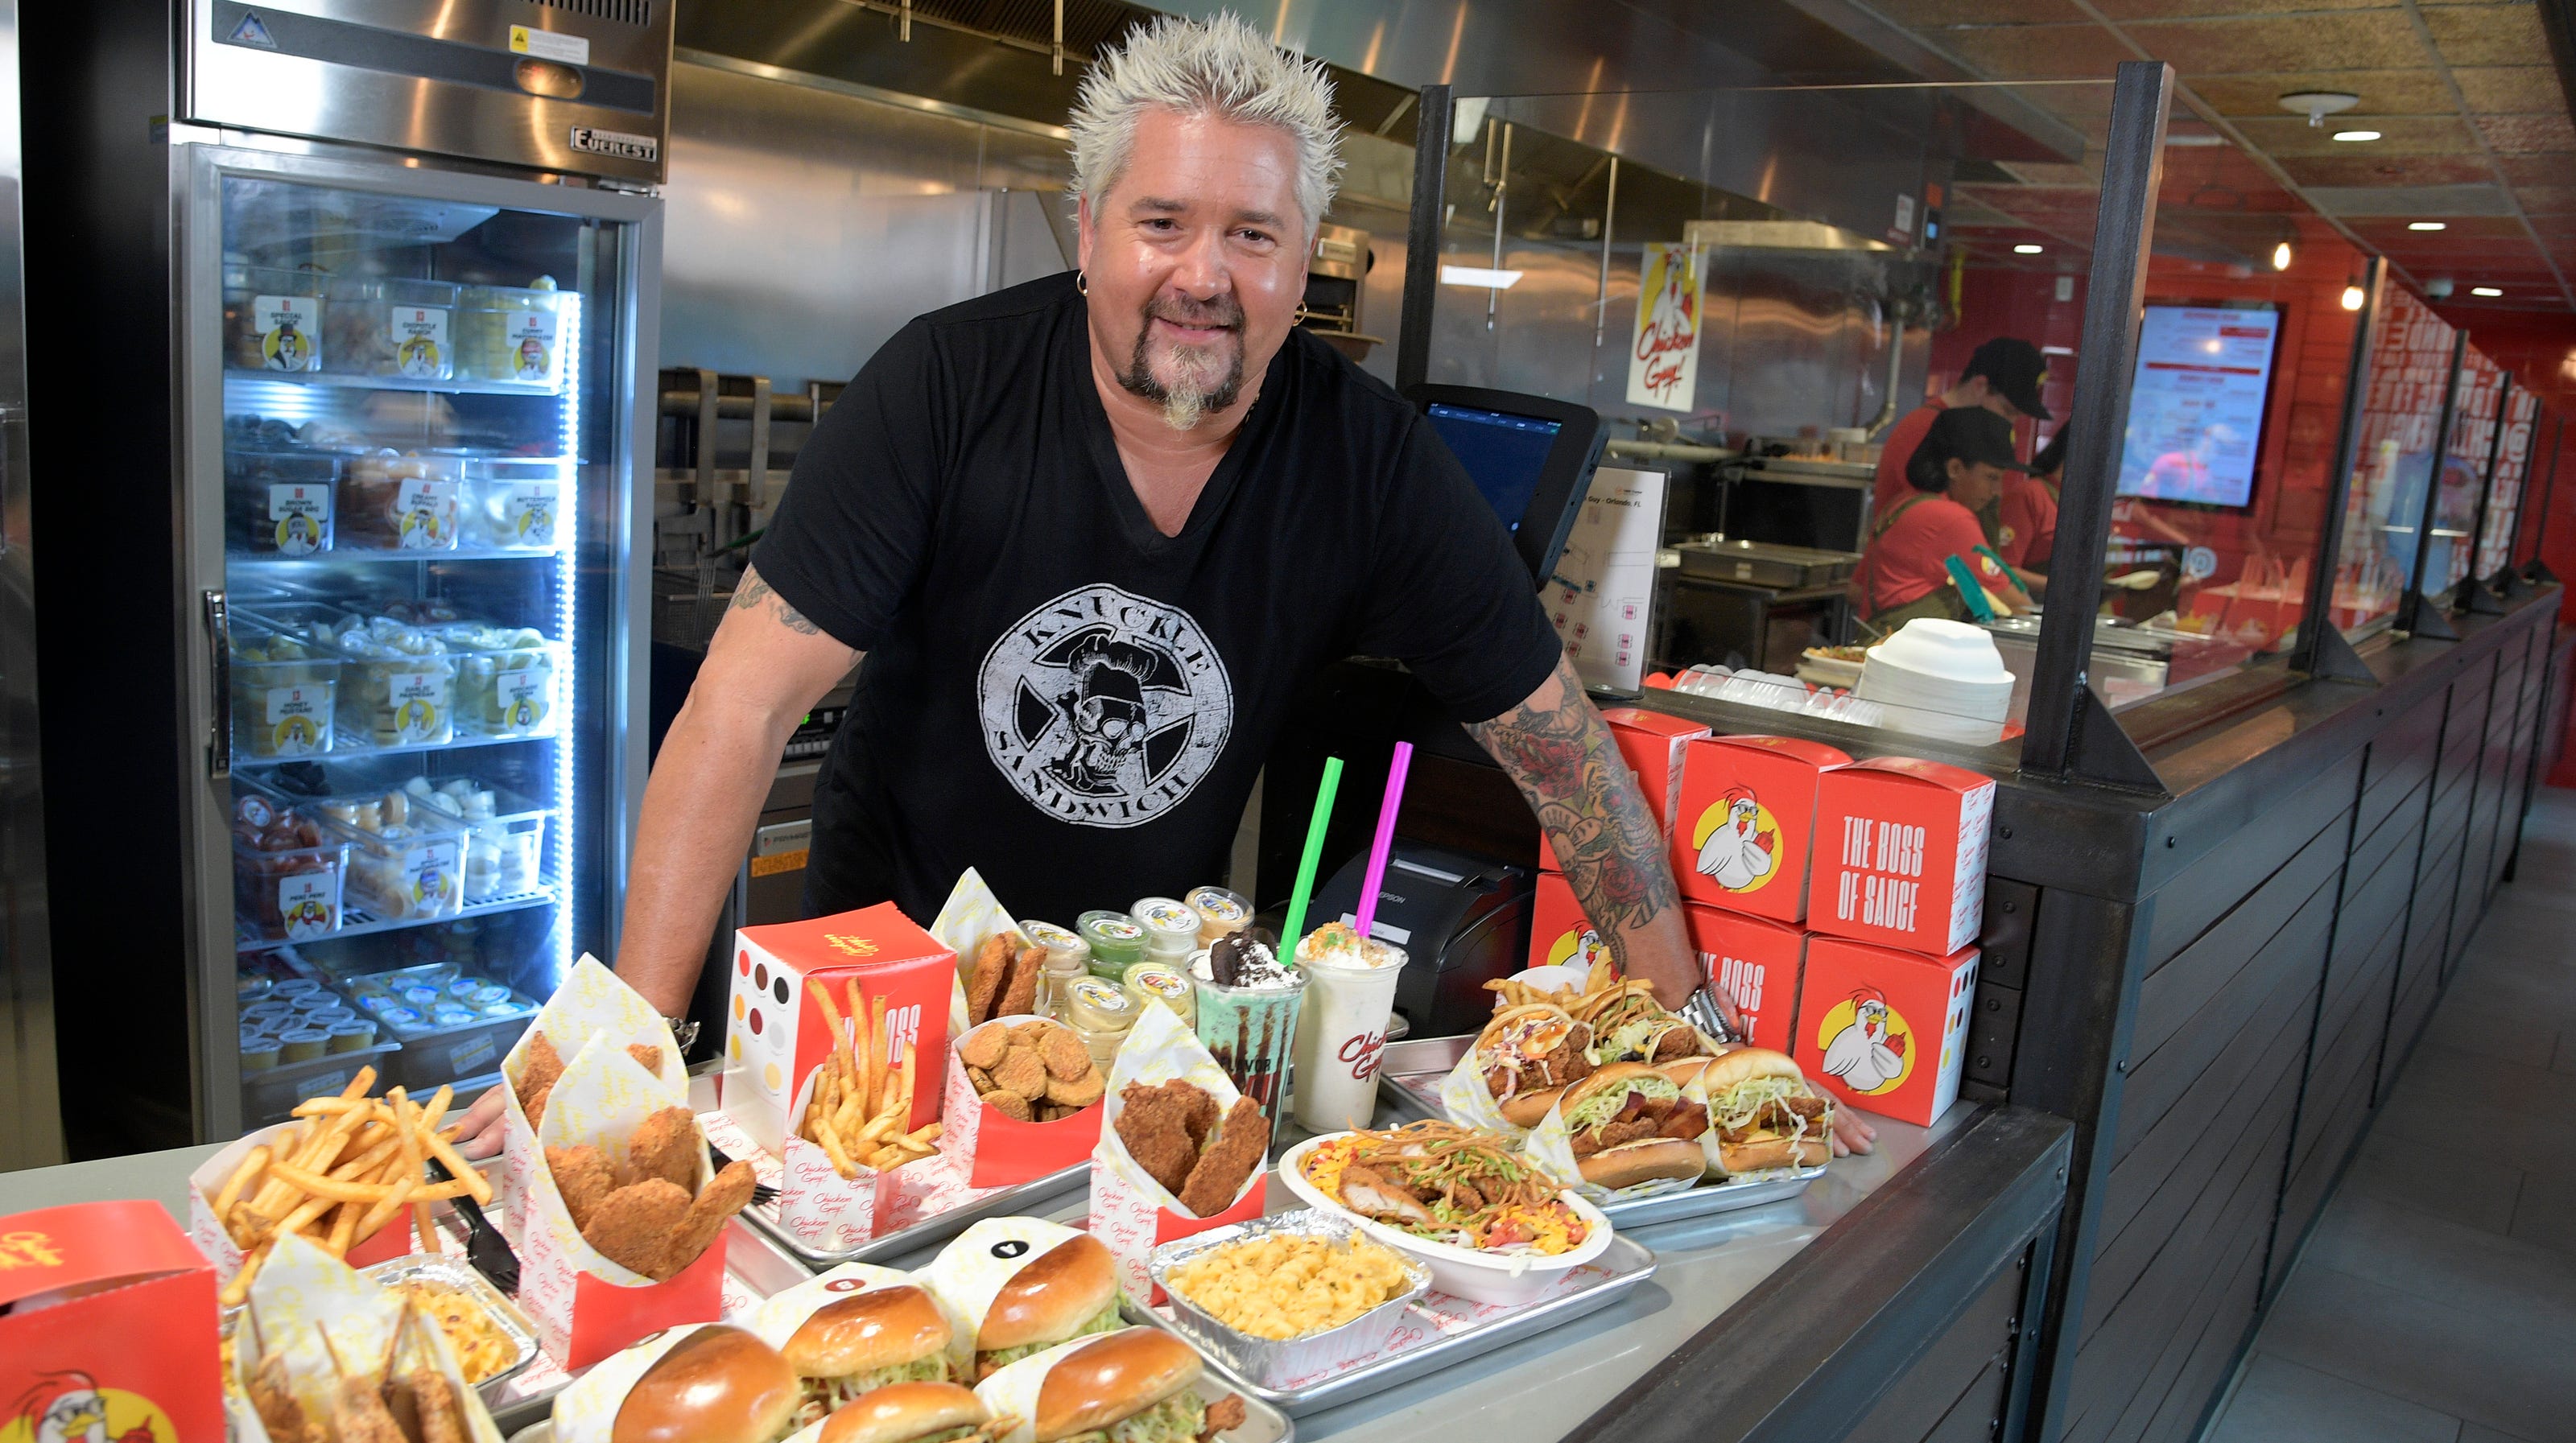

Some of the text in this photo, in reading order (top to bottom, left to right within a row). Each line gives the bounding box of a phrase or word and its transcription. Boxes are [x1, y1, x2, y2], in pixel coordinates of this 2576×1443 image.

[575, 129, 654, 159] EVEREST
[1637, 320, 1694, 361] Chicken
[1645, 354, 1686, 404] Guy!
[1588, 496, 1600, 504] Guy
[1606, 497, 1633, 508] Orlando,
[1022, 595, 1212, 679] KNUCKLE
[991, 728, 1193, 822] SANDWICH
[1842, 815, 1926, 877] THE BOSS
[1378, 892, 1406, 904] EPSON
[1837, 870, 1920, 933] OF SAUCE
[1719, 956, 1765, 1012] BOSS
[886, 1004, 922, 1065] OSS
[1339, 1022, 1389, 1062] Chick
[795, 1162, 834, 1174] Chicken
[801, 1173, 828, 1187] Guy!
[813, 1193, 852, 1205] Chicken
[819, 1203, 846, 1217] Guy!
[791, 1216, 830, 1228] Chicken
[796, 1227, 823, 1241] Guy!
